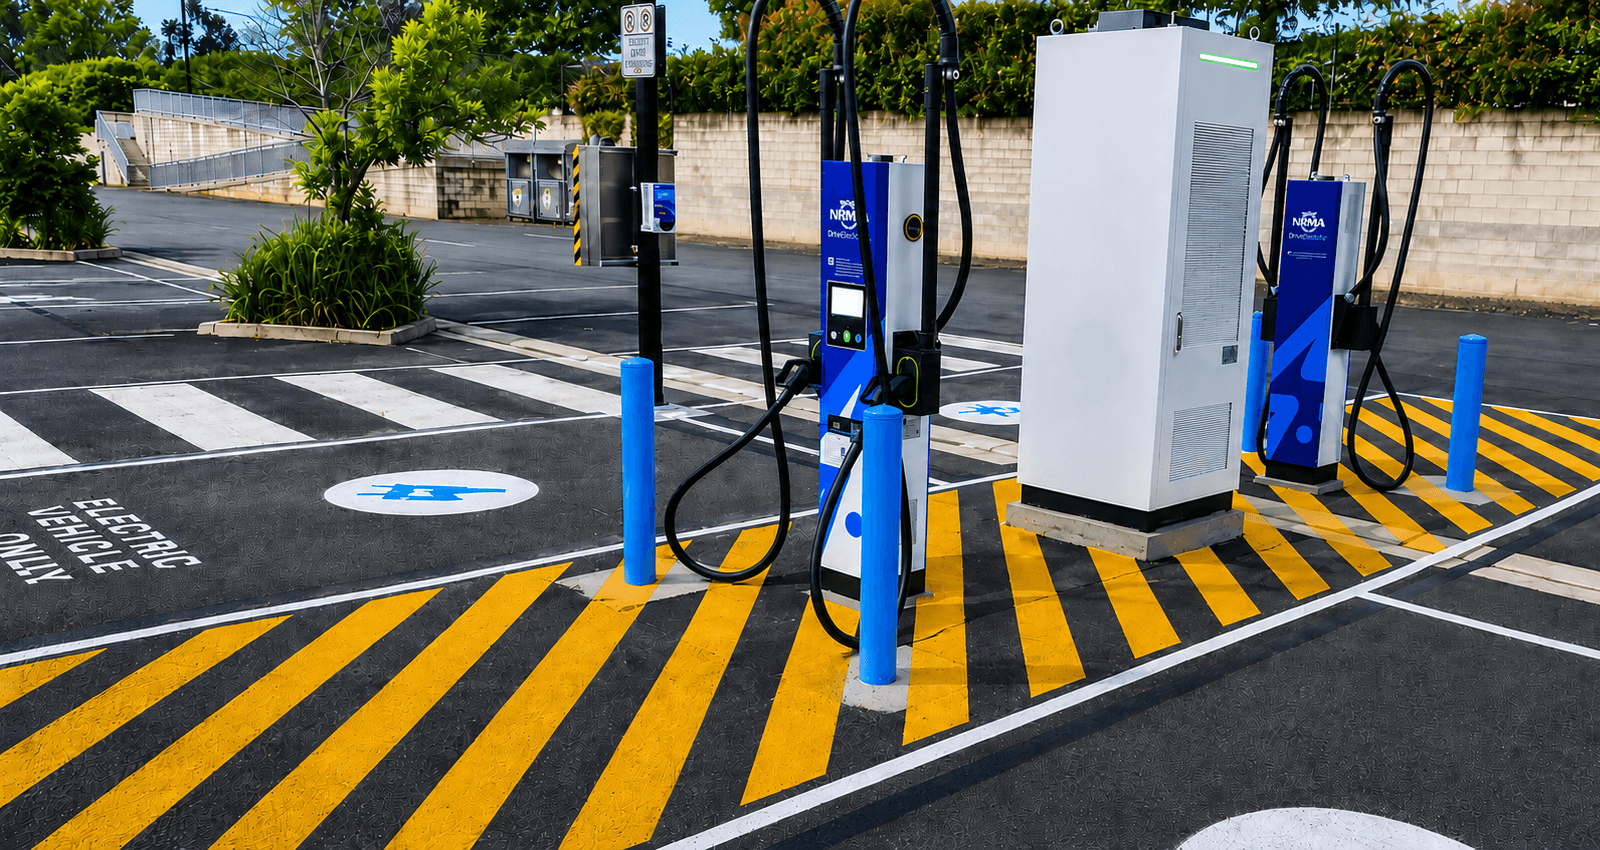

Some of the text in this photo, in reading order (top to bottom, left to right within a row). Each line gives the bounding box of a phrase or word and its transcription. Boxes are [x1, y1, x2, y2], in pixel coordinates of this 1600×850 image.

[830, 209, 869, 222] NRM
[1292, 217, 1325, 227] NRMA
[27, 505, 141, 575] VEHICLE
[72, 497, 203, 569] ELECTRIC
